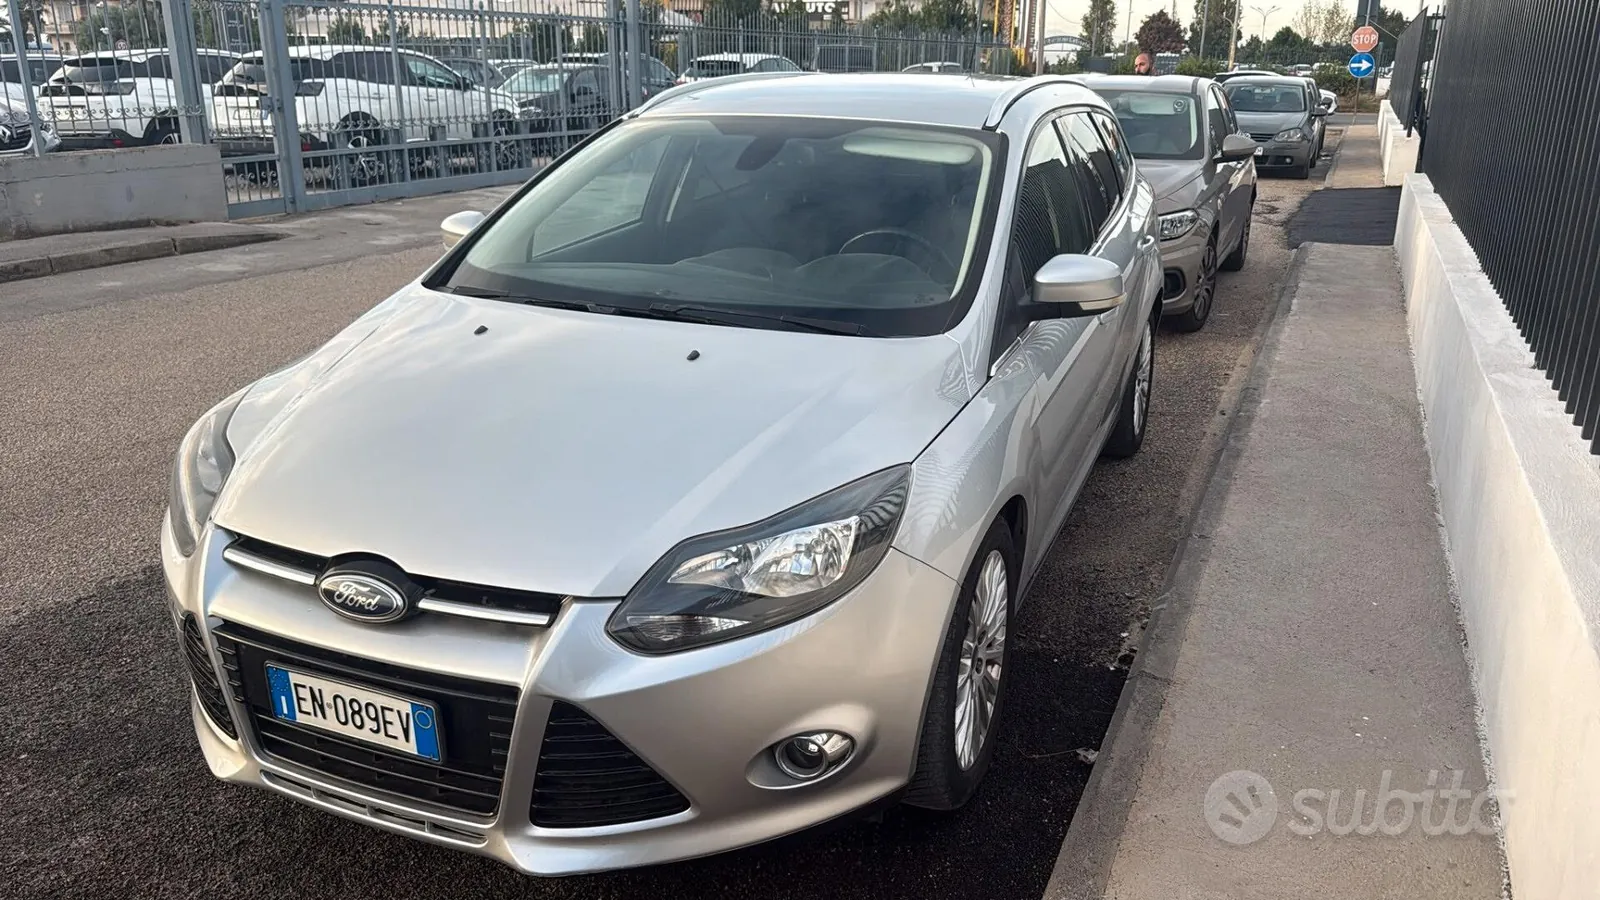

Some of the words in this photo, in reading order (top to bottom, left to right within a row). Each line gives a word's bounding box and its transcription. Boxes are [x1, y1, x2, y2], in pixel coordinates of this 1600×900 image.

[799, 2, 836, 13] UTO
[1353, 34, 1377, 45] STOP
[334, 581, 382, 612] Ford
